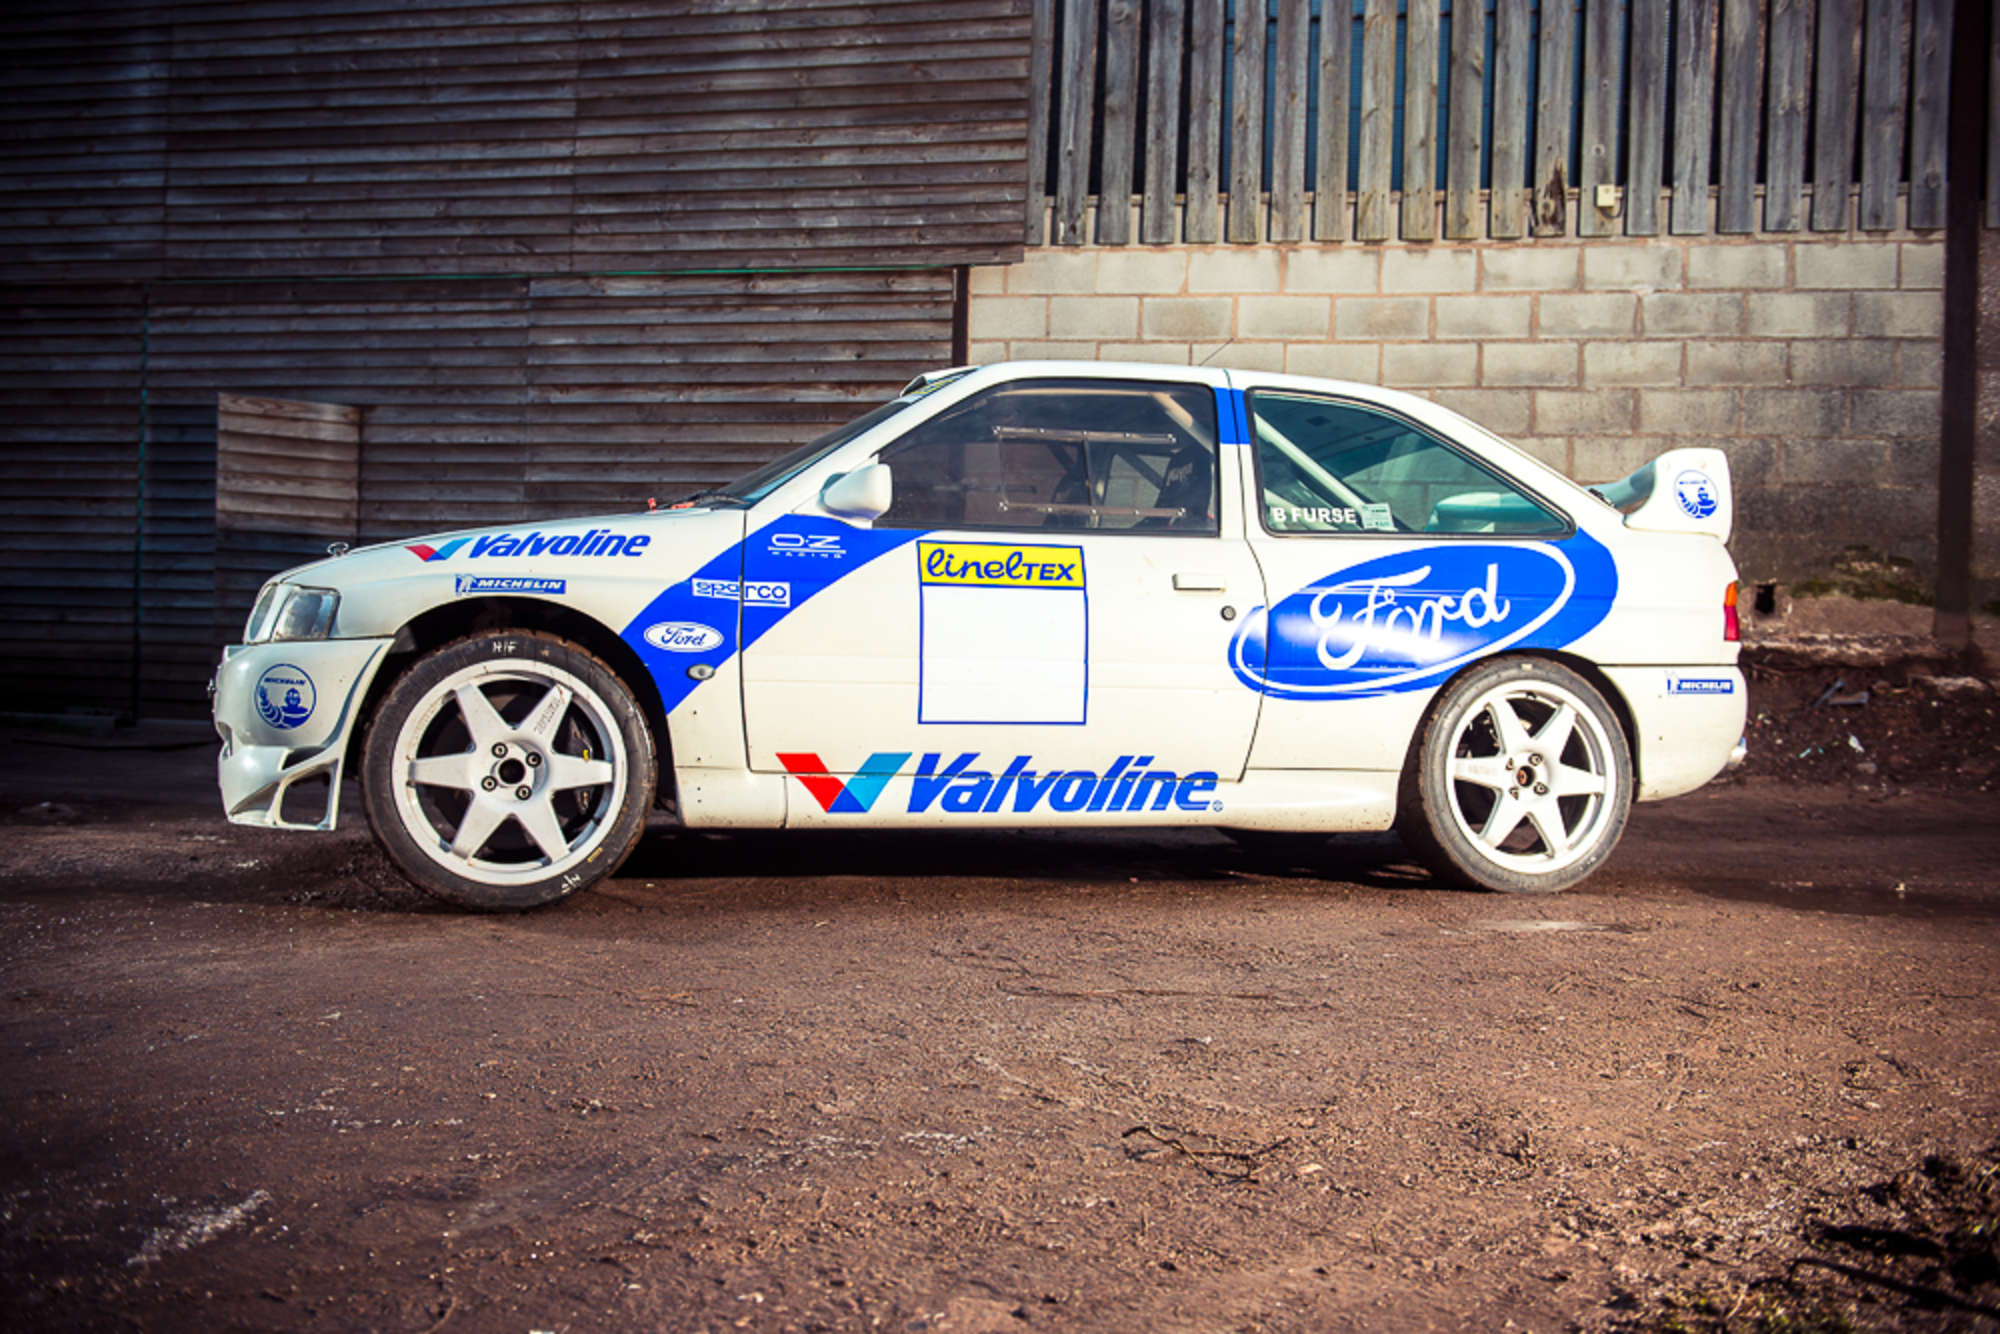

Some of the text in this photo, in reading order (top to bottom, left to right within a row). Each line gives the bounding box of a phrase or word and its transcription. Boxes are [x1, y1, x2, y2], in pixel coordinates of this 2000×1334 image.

[1272, 507, 1287, 522] B
[1291, 507, 1357, 523] FURSE
[468, 529, 651, 558] Valvoline
[477, 579, 563, 590] MICHELIN
[696, 582, 787, 599] sparco
[1310, 563, 1511, 671] Ford
[661, 627, 707, 645] Ford
[907, 752, 1219, 813] Valvoline
